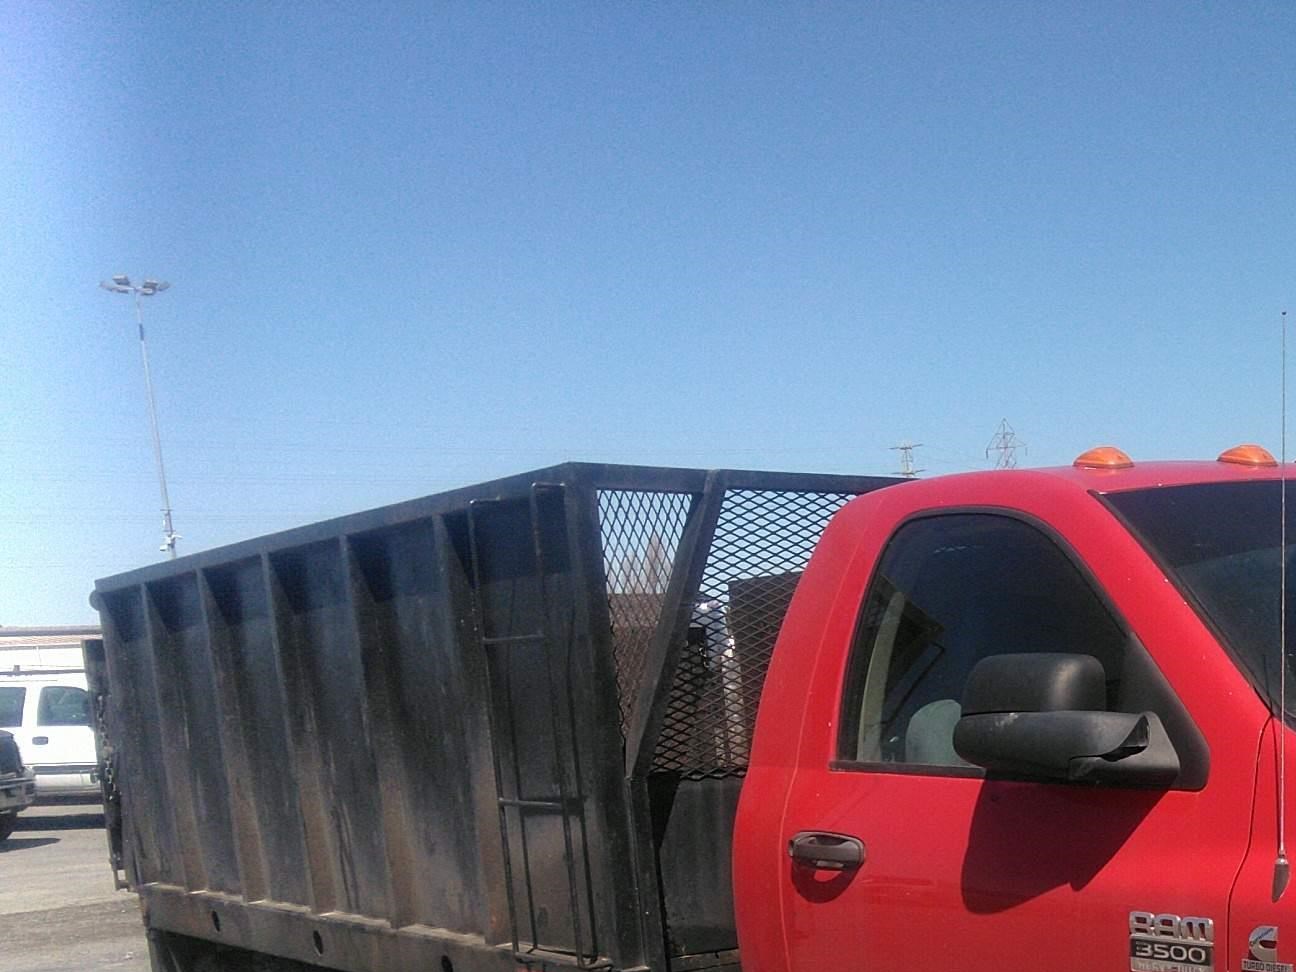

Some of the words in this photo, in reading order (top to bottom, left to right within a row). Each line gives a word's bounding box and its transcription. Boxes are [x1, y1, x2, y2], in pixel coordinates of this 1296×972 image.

[1129, 911, 1214, 942] RAM
[1135, 941, 1206, 963] 3500
[1243, 960, 1265, 970] TURBO
